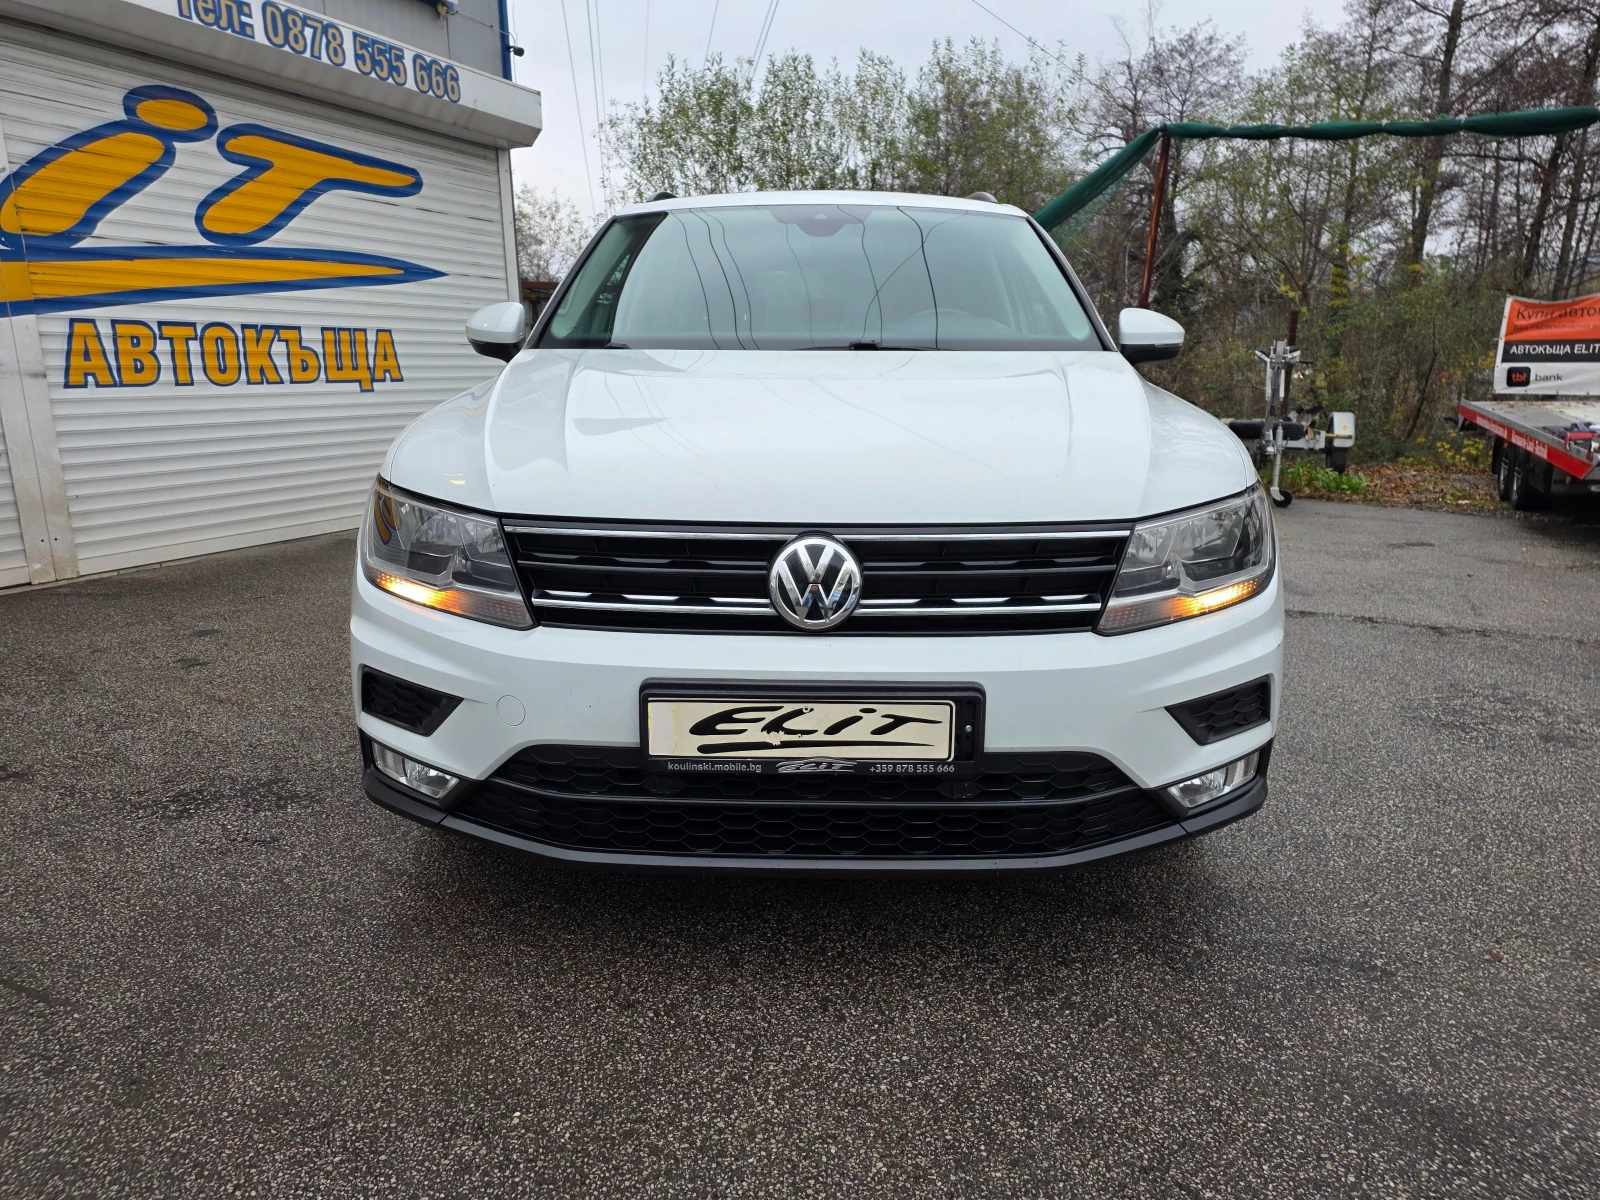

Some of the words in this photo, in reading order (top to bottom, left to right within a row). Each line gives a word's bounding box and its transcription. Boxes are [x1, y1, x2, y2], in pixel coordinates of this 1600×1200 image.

[262, 1, 346, 67] 0878
[352, 31, 407, 86] 555
[412, 53, 461, 103] 666
[1516, 307, 1556, 320] Купи
[1558, 305, 1600, 319] авто
[63, 318, 403, 392] АВТОКЪЩА
[1509, 344, 1571, 355] АВТОКЪЩА
[1535, 372, 1563, 382] bank
[667, 762, 762, 773] koulinski.mobile.bg
[869, 764, 894, 773] +359
[895, 764, 914, 773] 878
[916, 764, 935, 773] 555
[936, 764, 955, 773] 666
